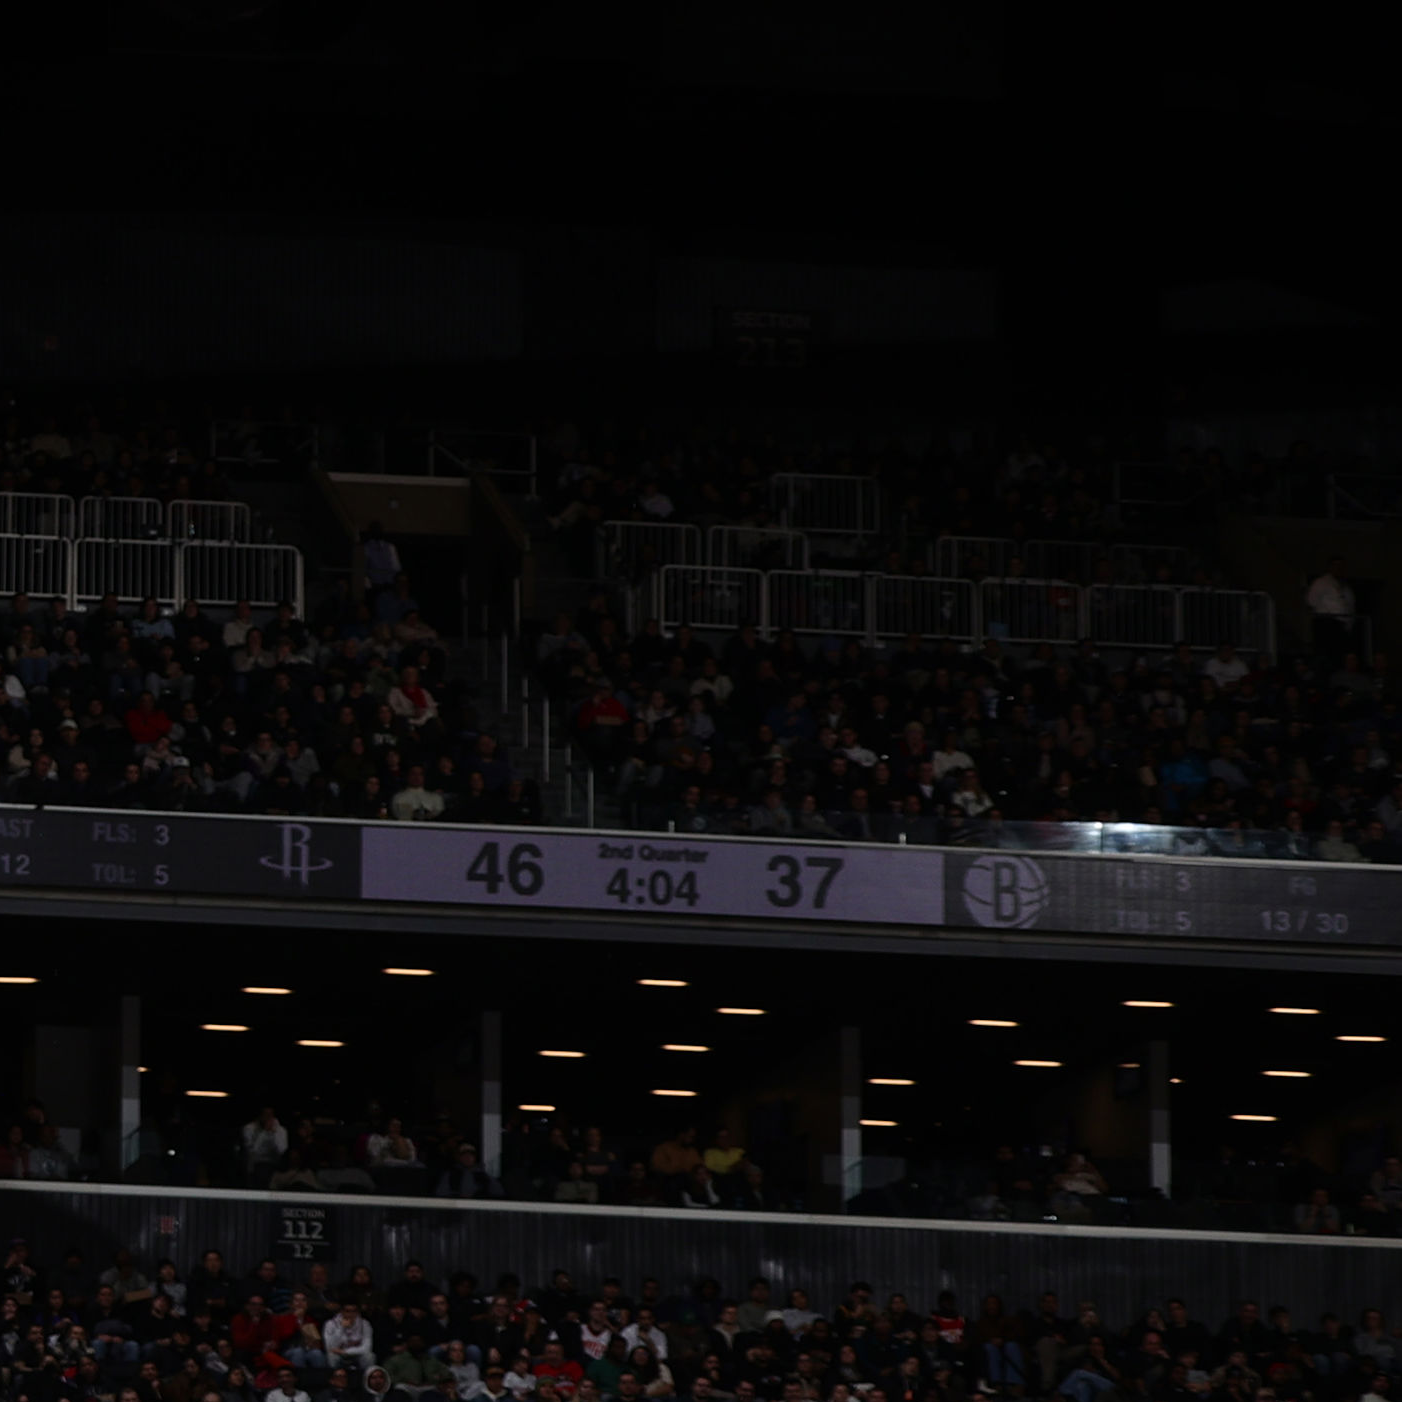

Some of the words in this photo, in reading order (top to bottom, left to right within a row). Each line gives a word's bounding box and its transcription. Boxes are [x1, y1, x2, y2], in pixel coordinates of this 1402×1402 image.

[154, 824, 170, 846] 3
[599, 842, 634, 861] 2nd
[639, 844, 709, 864] Quarter
[1, 853, 31, 876] 12
[466, 841, 545, 896] 46
[153, 865, 170, 887] 5
[766, 855, 844, 909] 37
[1176, 871, 1191, 893] 3
[606, 868, 700, 908] 4:04
[1175, 911, 1192, 932] 5
[1261, 909, 1292, 932] 13
[1316, 914, 1348, 935] 30
[283, 1220, 325, 1240] 112
[294, 1244, 314, 1259] 12
